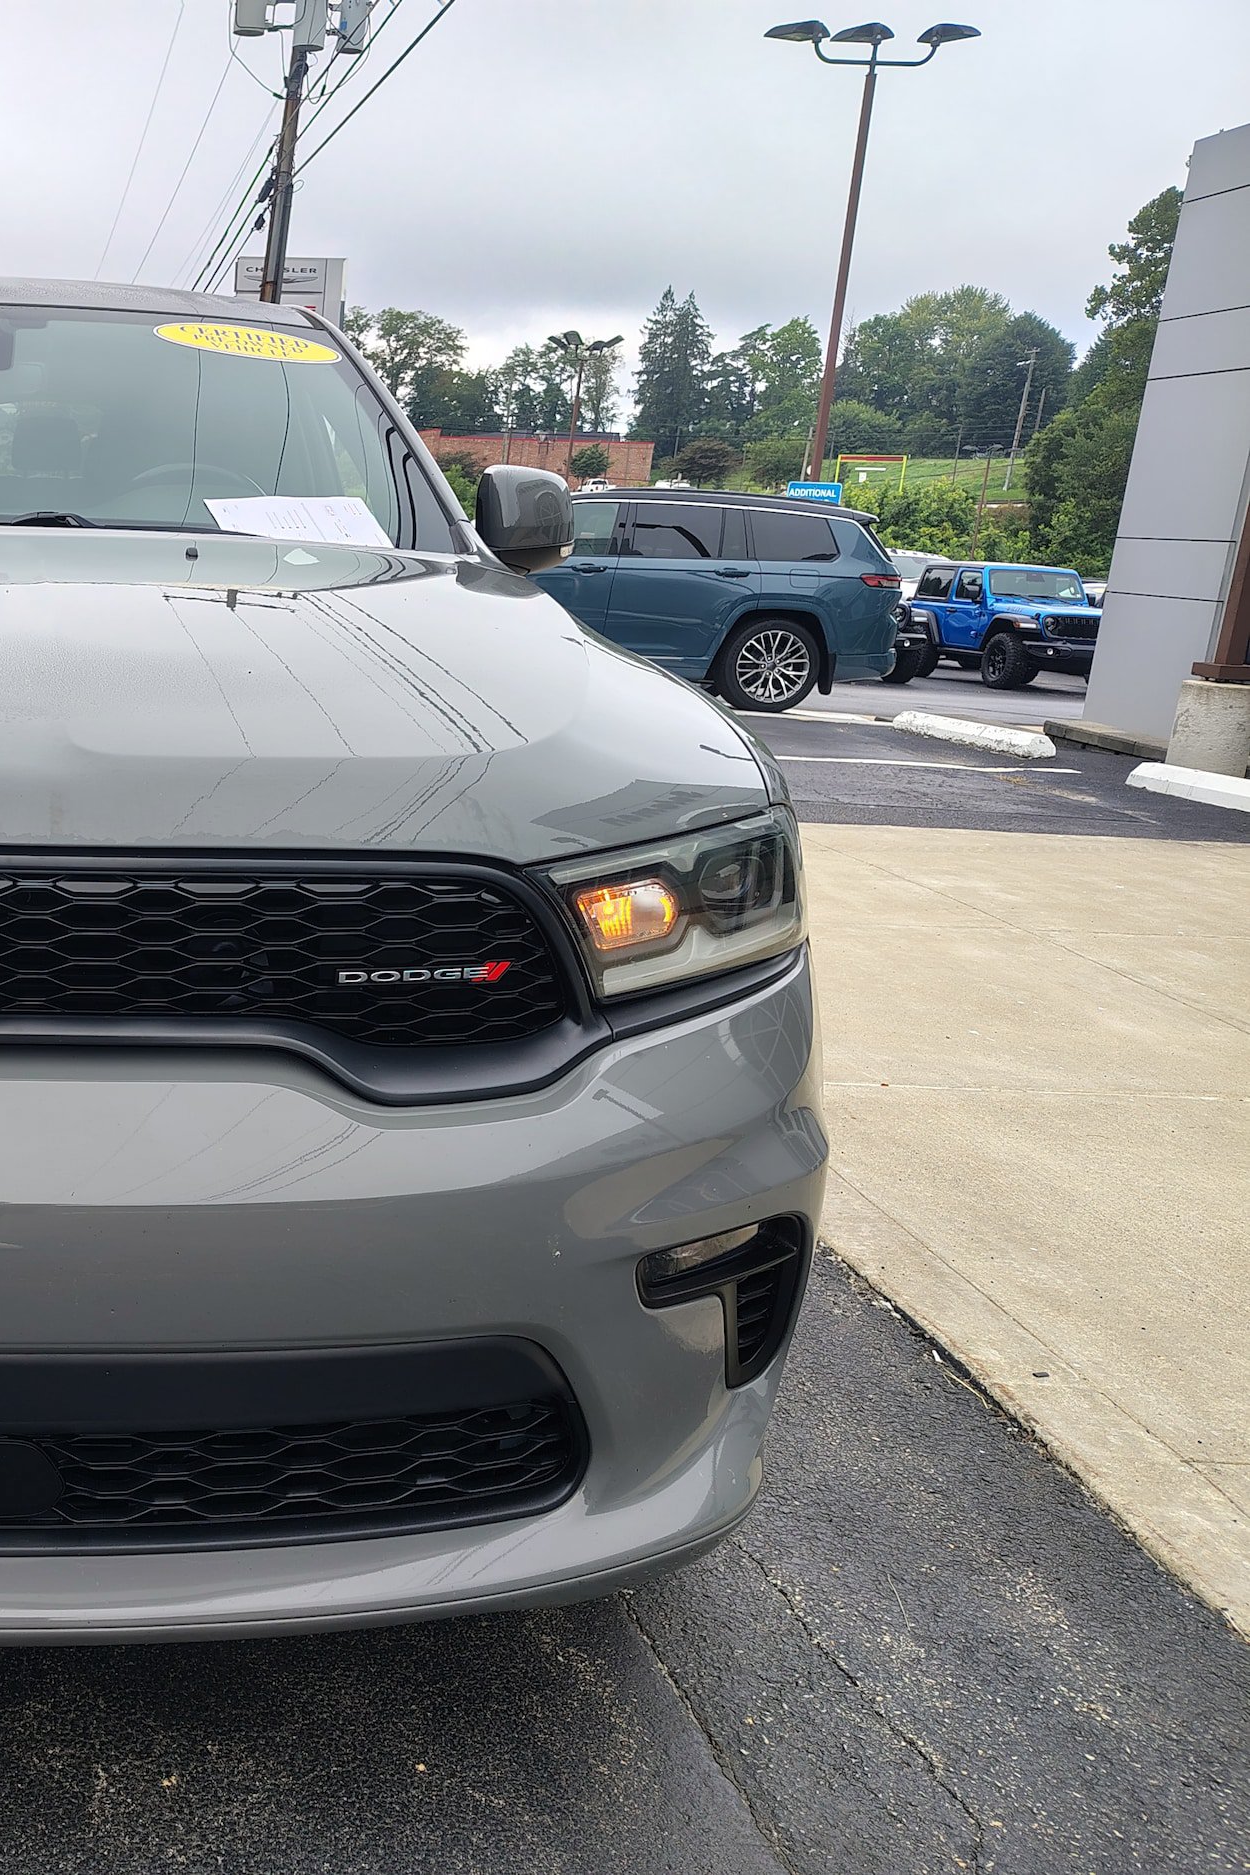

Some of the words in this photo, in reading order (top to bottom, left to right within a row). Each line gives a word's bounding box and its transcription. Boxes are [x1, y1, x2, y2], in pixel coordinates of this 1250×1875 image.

[245, 266, 318, 274] CHSLER
[180, 326, 309, 348] CERTIFIED
[194, 334, 303, 353] PRE-OWNED
[211, 341, 288, 357] VEHICLE
[788, 488, 836, 497] ADDITIONAL
[338, 966, 490, 984] DODGE
